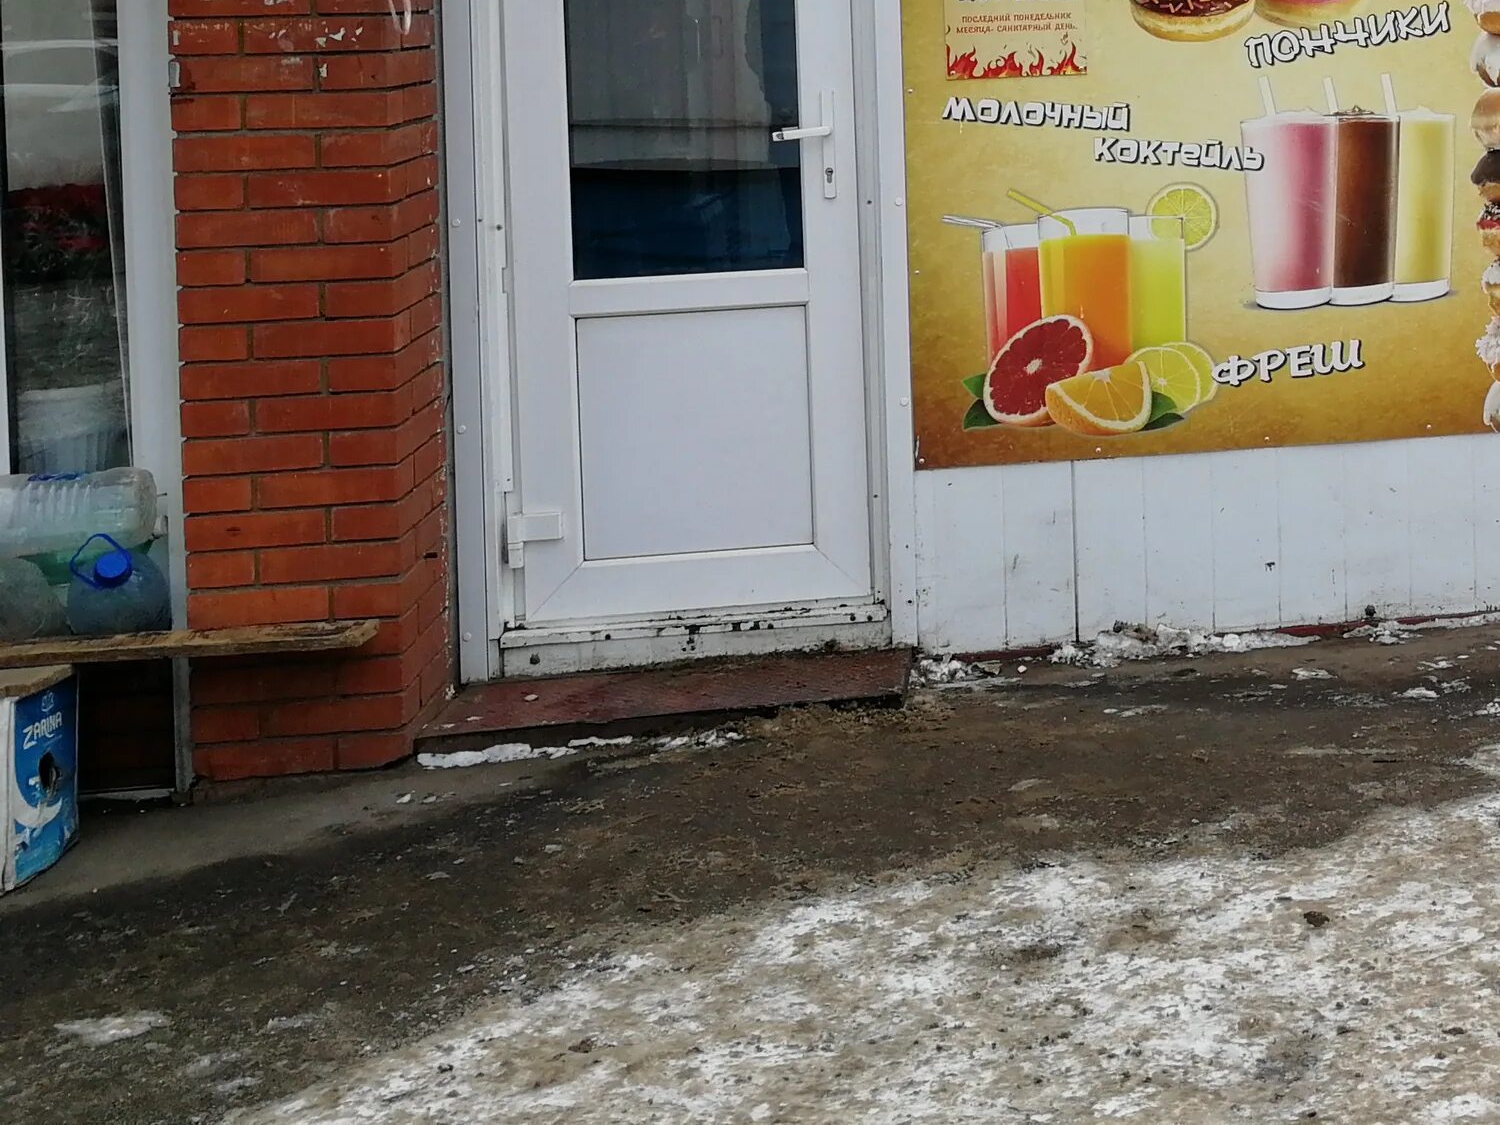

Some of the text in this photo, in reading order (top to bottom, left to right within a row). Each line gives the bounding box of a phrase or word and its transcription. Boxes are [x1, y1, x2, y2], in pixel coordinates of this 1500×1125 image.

[961, 11, 1072, 24] ПОСЛЕДНИЙ ПОНЕДЕЛЬНИК
[996, 23, 1052, 33] САНИТАРНЫЙ
[1244, 0, 1451, 69] ПОНЧИКИ
[1211, 338, 1367, 387] ФРЕШ
[22, 711, 63, 750] ZARINA
